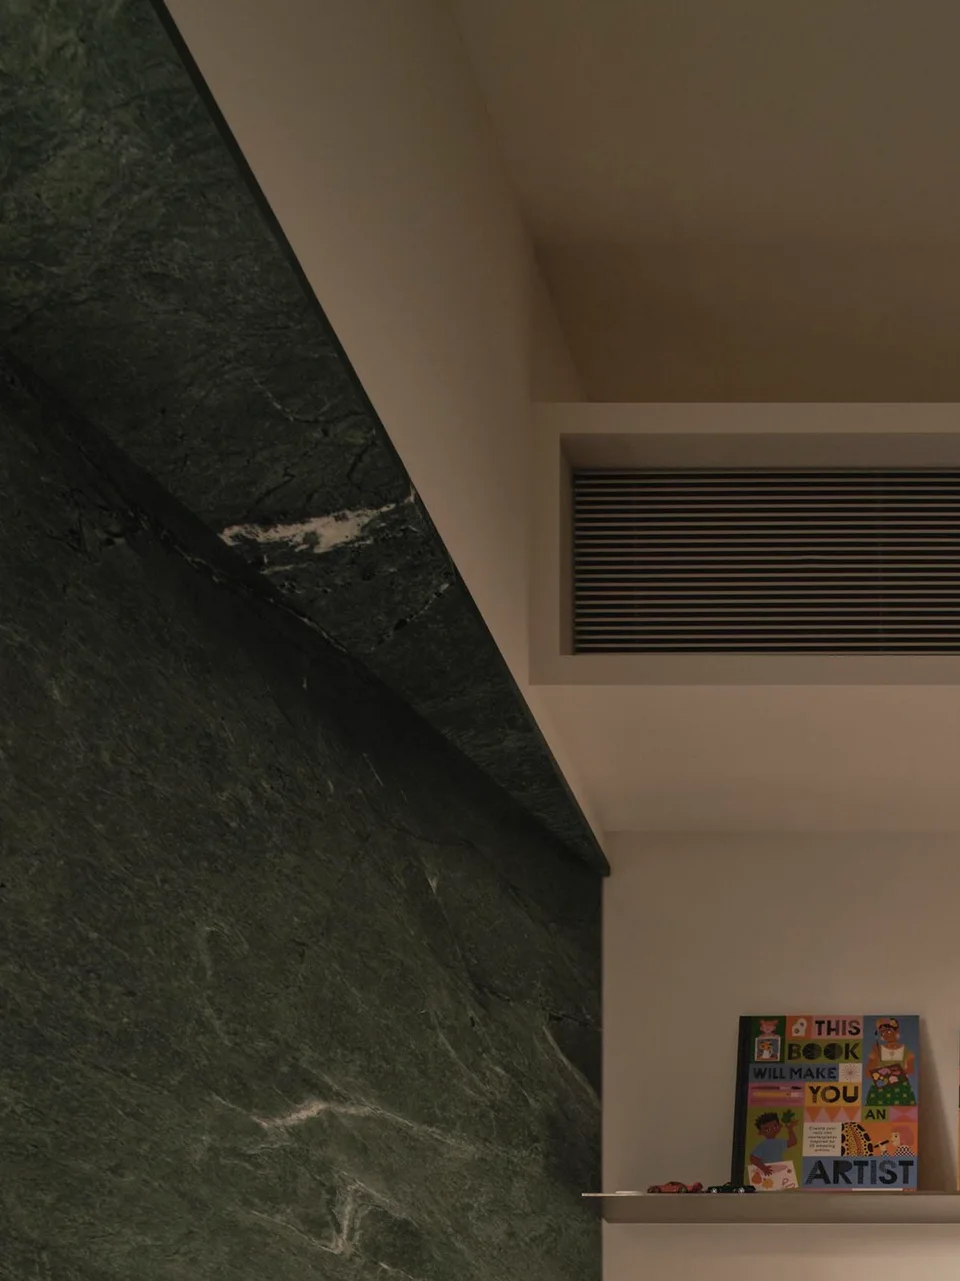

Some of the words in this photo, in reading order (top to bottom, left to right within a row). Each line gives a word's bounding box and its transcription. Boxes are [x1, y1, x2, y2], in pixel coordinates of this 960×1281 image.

[814, 1020, 861, 1036] THIS
[787, 1042, 860, 1061] BOOK
[752, 1067, 786, 1080] WILL
[789, 1067, 837, 1080] MAKE
[808, 1085, 860, 1103] YOU
[864, 1109, 887, 1120] AN
[804, 1160, 914, 1185] ARTIST
